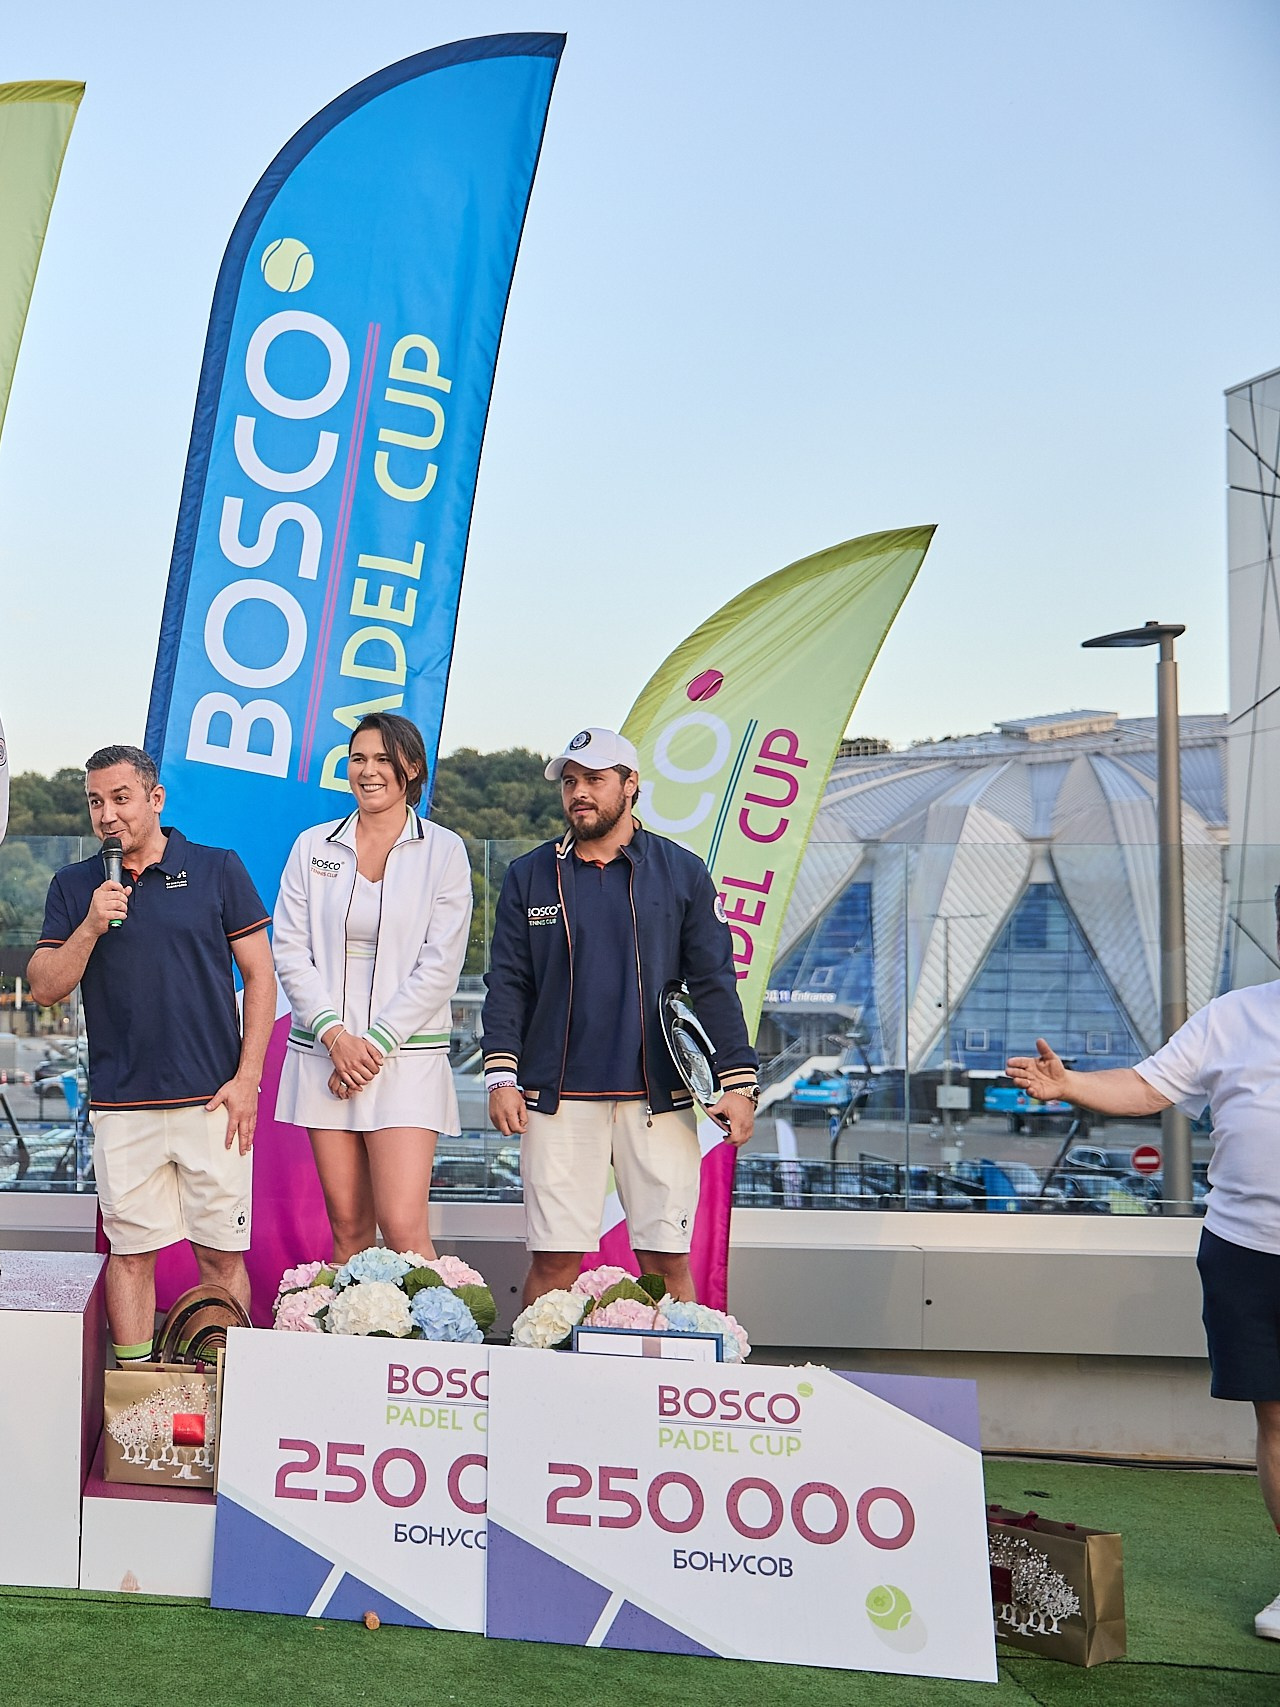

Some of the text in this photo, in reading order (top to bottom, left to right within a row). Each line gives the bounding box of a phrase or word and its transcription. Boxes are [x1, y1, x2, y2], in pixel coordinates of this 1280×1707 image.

[374, 333, 453, 503] CUP
[185, 309, 351, 780] BOSCO
[311, 856, 341, 871] BOSCO
[719, 727, 810, 980] DEL CUP
[310, 867, 327, 877] TENNIS
[791, 989, 838, 1003] Entrance
[387, 1363, 489, 1401] BOSC
[385, 1404, 463, 1431] PADEL
[658, 1384, 801, 1425] BOSCO
[657, 1427, 802, 1458] PADEL CUP
[274, 1438, 427, 1508] 250
[545, 1462, 705, 1534] 250
[726, 1476, 915, 1550] 000
[394, 1523, 487, 1550] БОНУСО
[672, 1548, 794, 1578] БОНУСОВ
